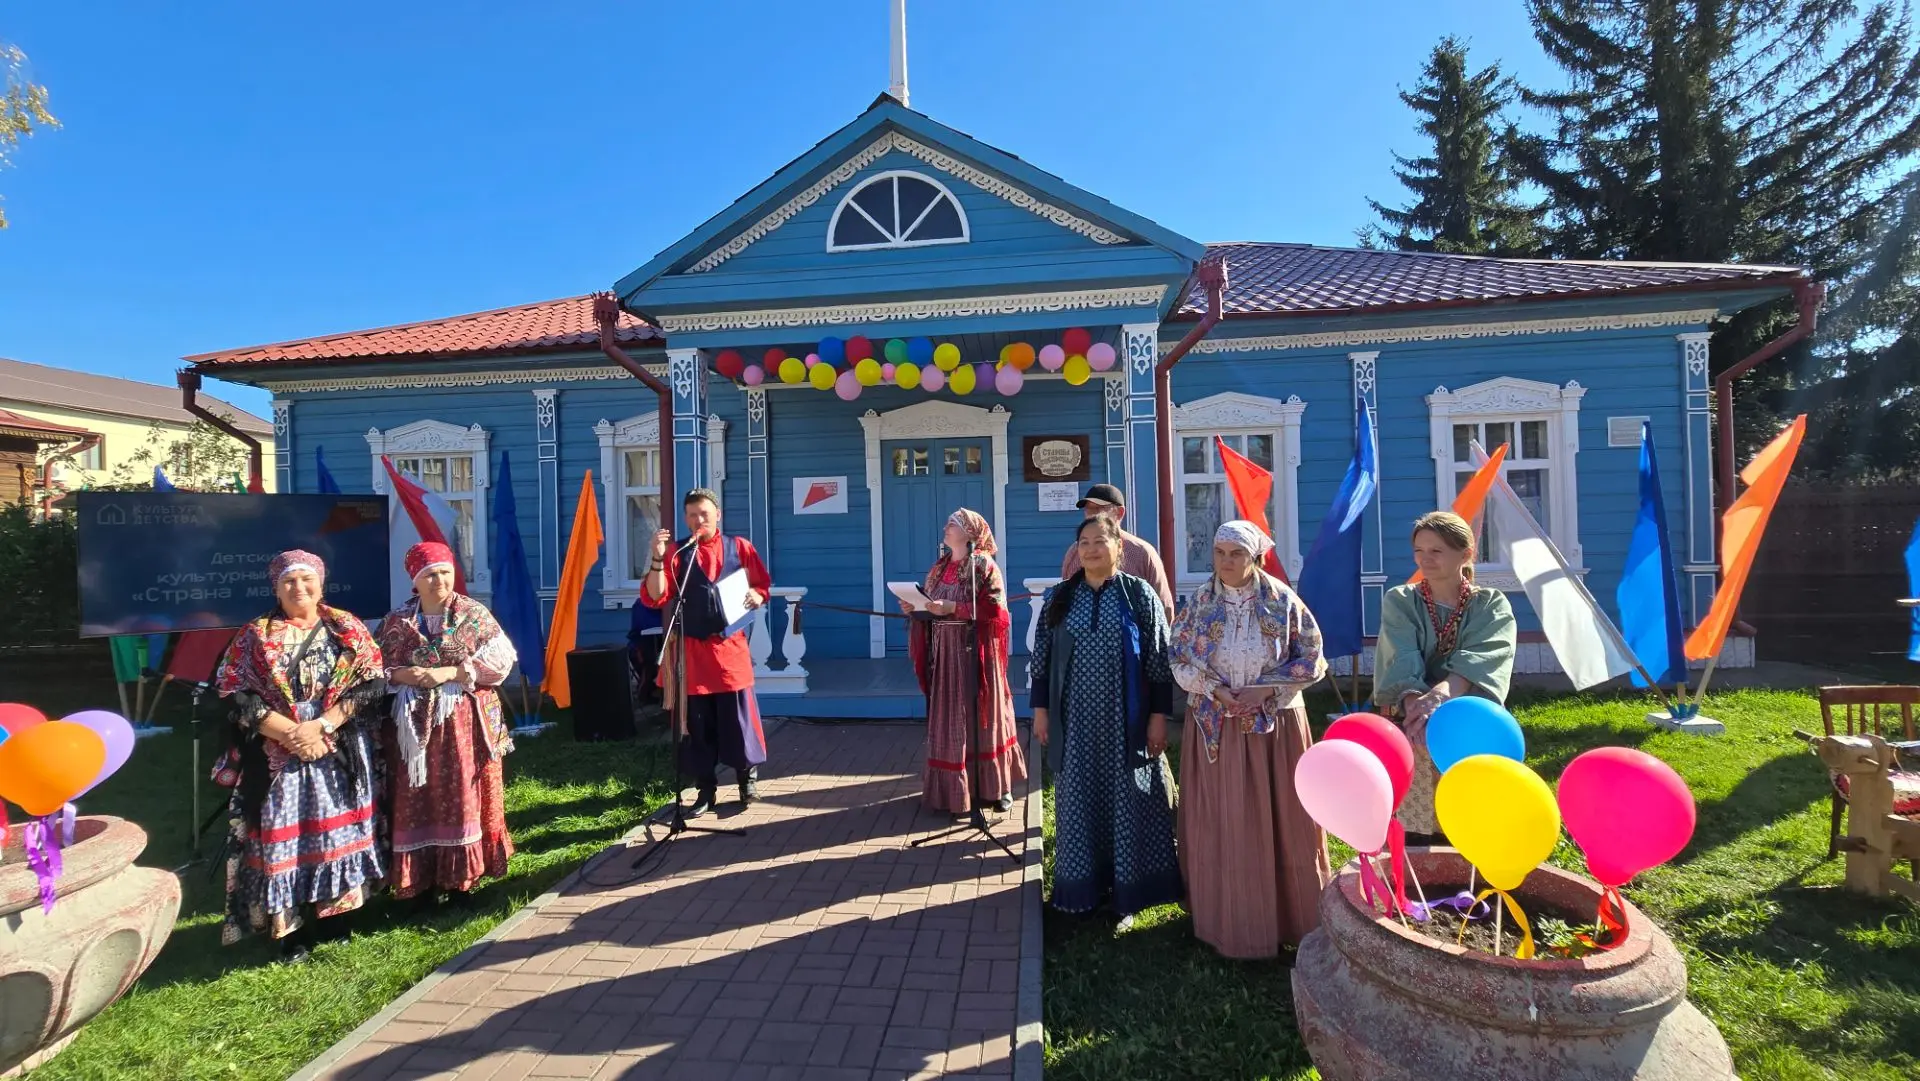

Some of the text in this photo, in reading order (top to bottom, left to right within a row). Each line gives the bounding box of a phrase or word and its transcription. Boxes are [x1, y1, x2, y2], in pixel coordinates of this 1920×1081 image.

[133, 514, 198, 525] ДЕТСТВА
[211, 551, 281, 565] Детски
[132, 586, 232, 604] «Страна
